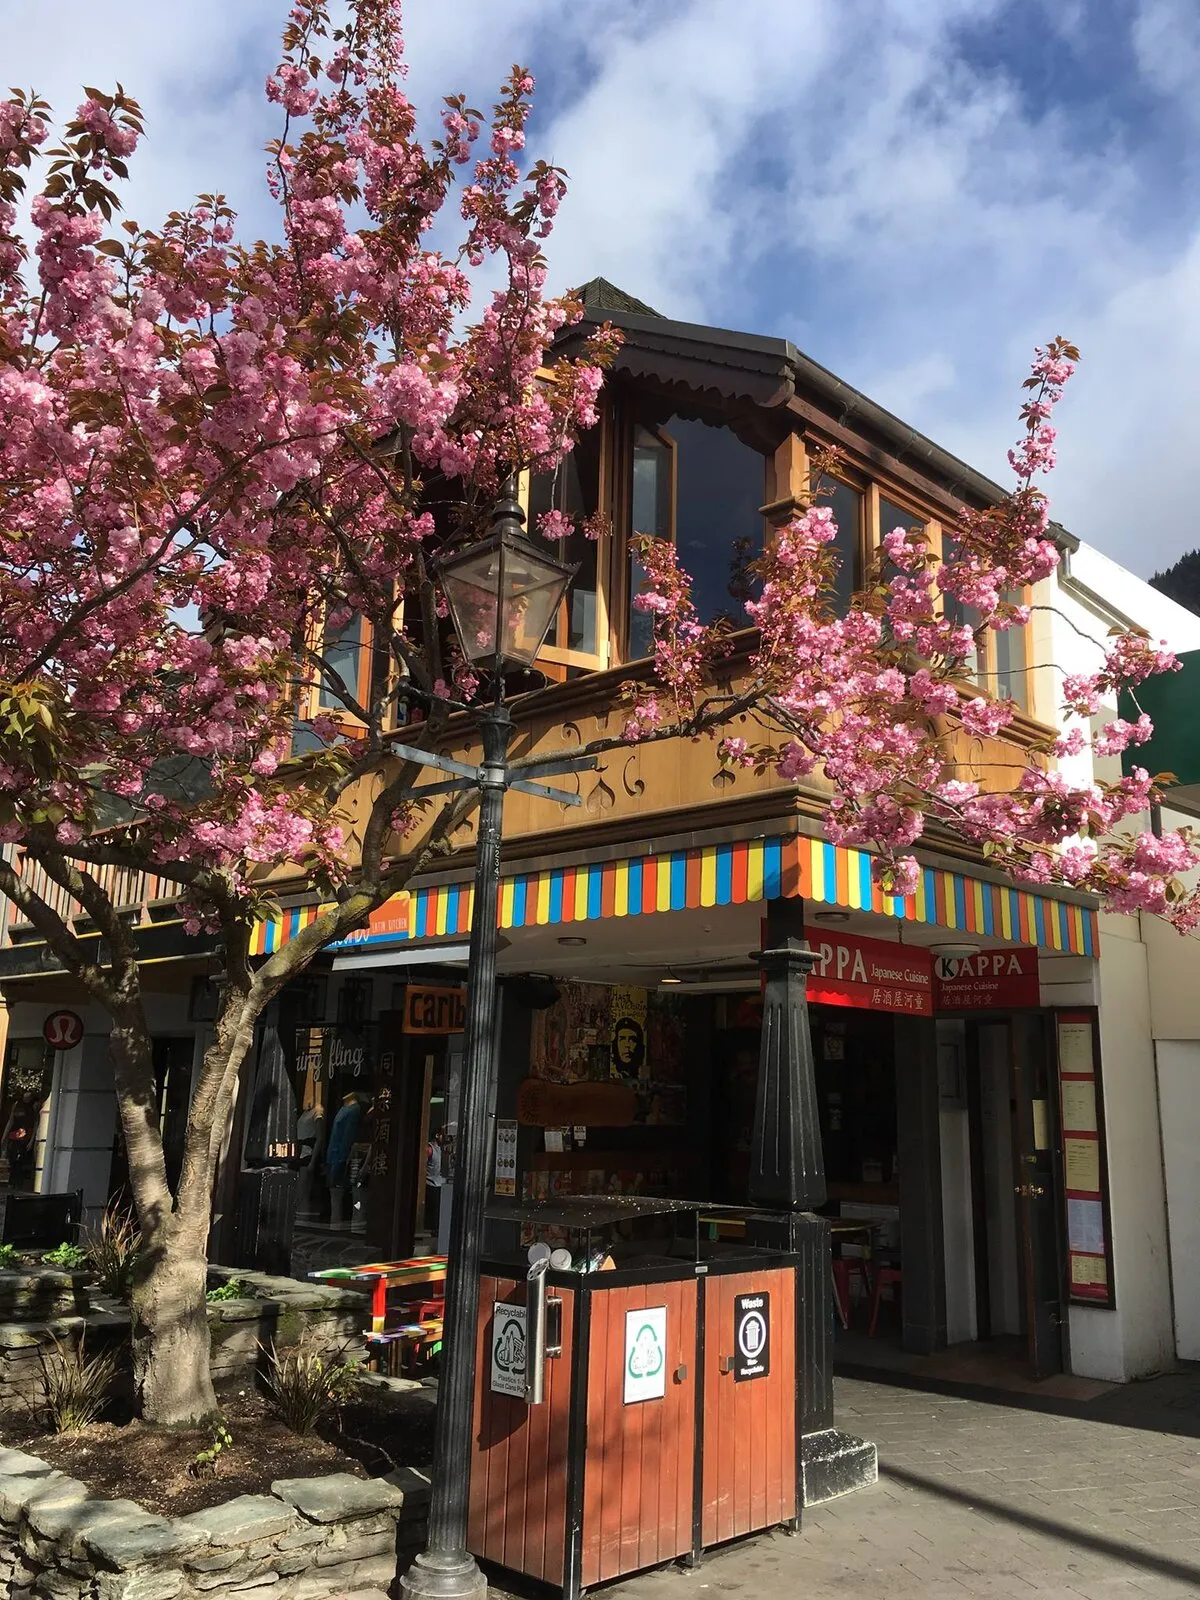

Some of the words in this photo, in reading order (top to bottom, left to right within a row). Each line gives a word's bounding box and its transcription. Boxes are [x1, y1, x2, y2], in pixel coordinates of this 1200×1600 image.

[870, 963, 903, 981] Japanese
[904, 968, 929, 985] Cuisine
[941, 954, 1023, 978] KAPPA
[941, 983, 972, 993] Japanese
[973, 981, 999, 991] Cuisine
[410, 992, 467, 1028] carib
[296, 1051, 324, 1082] ring
[328, 1038, 365, 1080] fling
[741, 1298, 764, 1310] Waste
